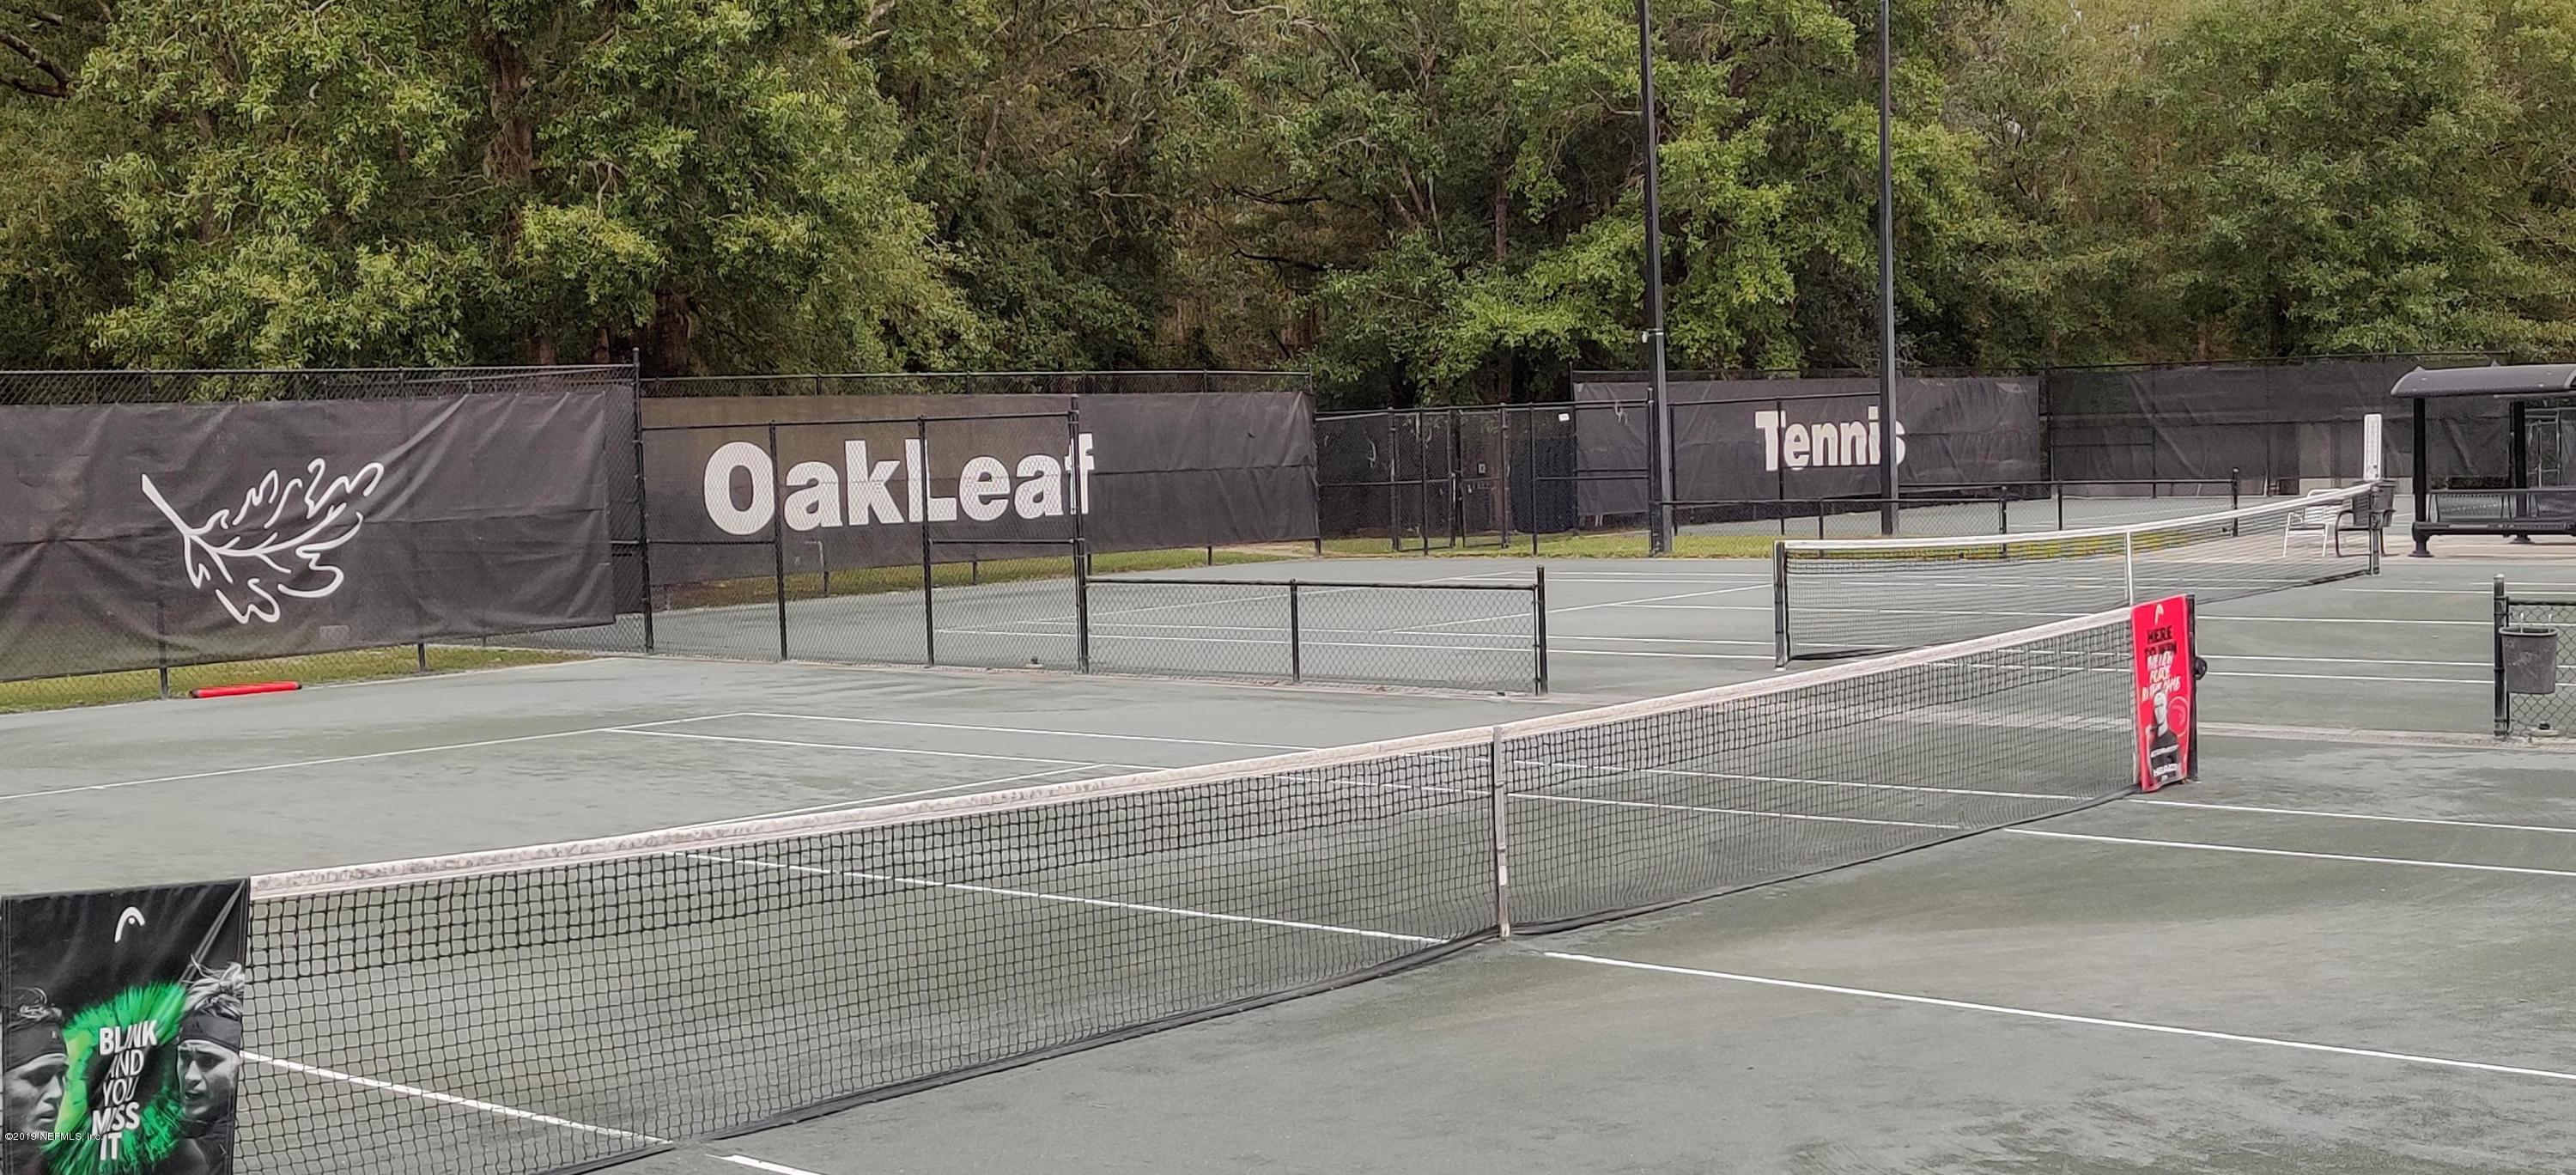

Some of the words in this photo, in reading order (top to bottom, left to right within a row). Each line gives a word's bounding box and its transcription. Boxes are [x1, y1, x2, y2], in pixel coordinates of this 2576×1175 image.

[704, 432, 1095, 535] OakLeaf
[100, 1020, 157, 1055] BLINK
[105, 1049, 144, 1079] AND
[102, 1075, 140, 1107] YOU
[92, 1101, 140, 1135] MISS
[100, 1132, 123, 1160] IT
